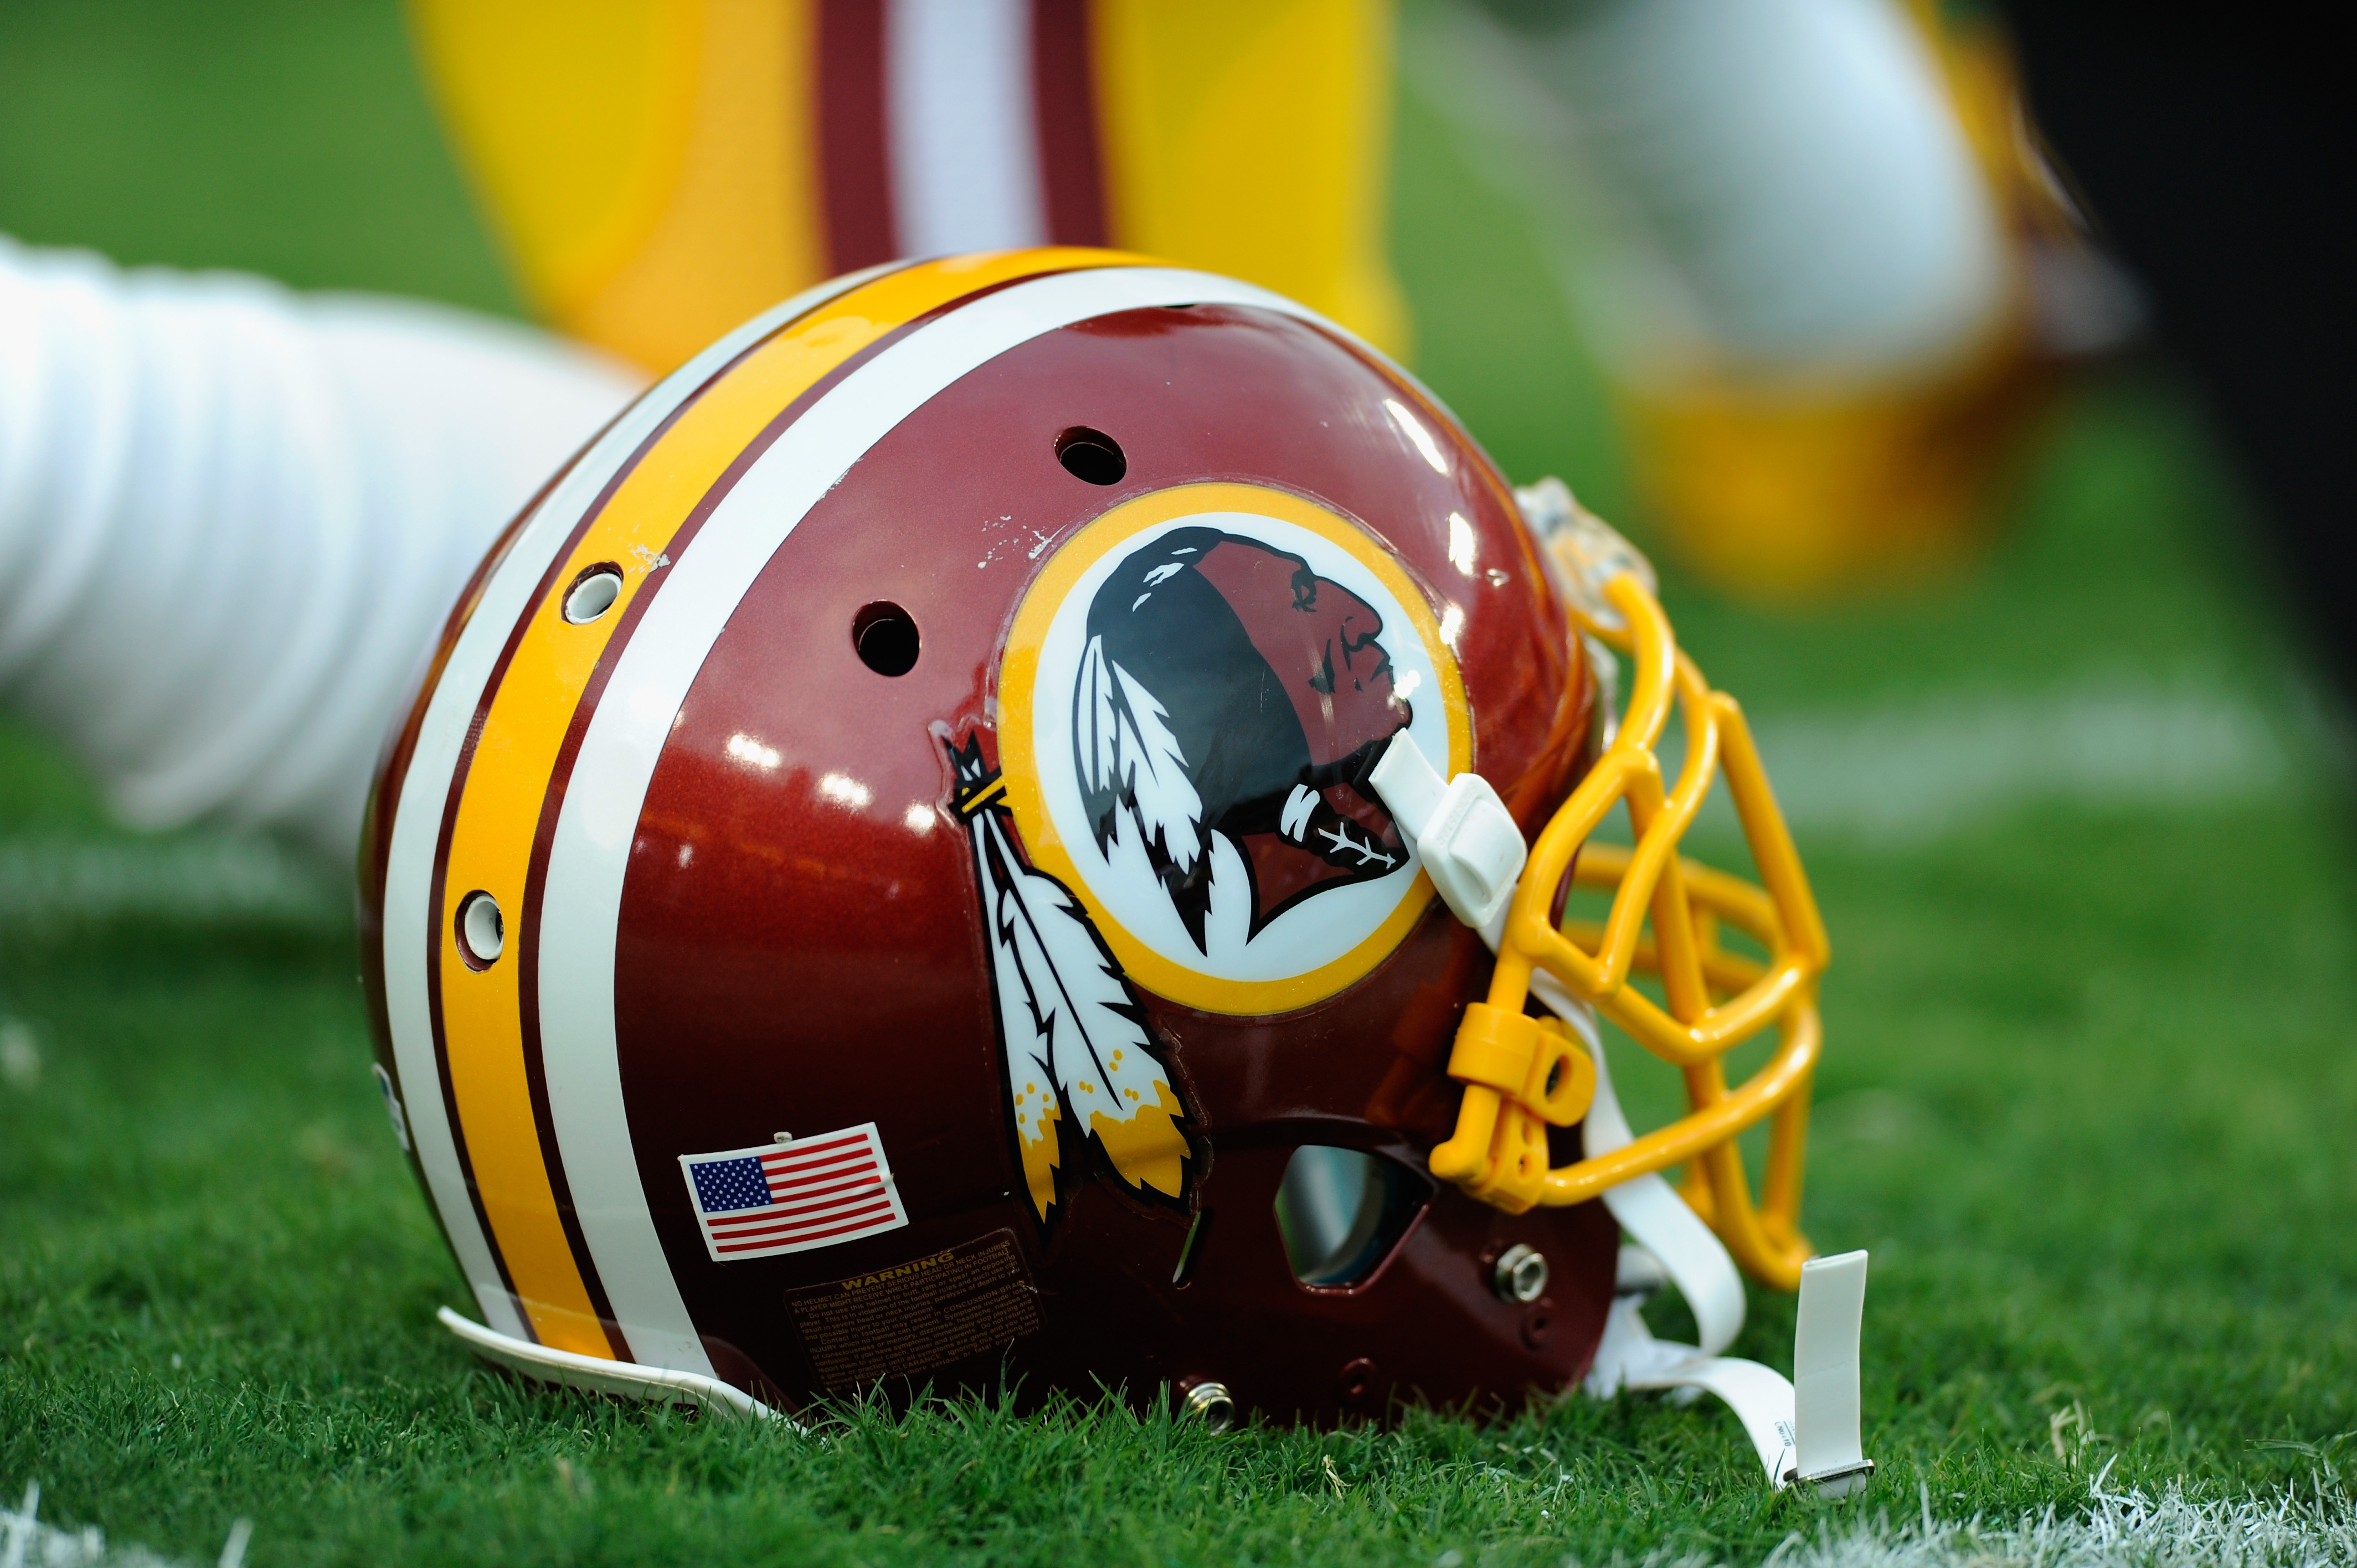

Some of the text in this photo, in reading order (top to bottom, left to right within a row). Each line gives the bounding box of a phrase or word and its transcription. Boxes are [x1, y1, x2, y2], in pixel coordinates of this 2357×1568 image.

[800, 1303, 828, 1312] PLAYER
[829, 1298, 851, 1307] MIGHT
[853, 1291, 884, 1303] RECEIVE
[886, 1283, 908, 1294] WHILE
[909, 1266, 964, 1287] PARTICIPATING
[803, 1295, 832, 1304] HELMET
[851, 1283, 885, 1296] PREVENT
[886, 1273, 920, 1287] SERIOUS
[921, 1266, 942, 1276] HEAD
[943, 1261, 955, 1270] OR
[955, 1254, 976, 1265] NECK
[977, 1239, 1011, 1257] INJURIES
[841, 1252, 954, 1291] WARNING
[857, 1305, 888, 1316] violation
[910, 1289, 937, 1302] football
[939, 1284, 957, 1292] rules
[958, 1278, 972, 1286] and
[972, 1271, 990, 1281] such
[991, 1266, 1004, 1275] use
[866, 1296, 891, 1307] helmet
[948, 1272, 969, 1282] spear
[832, 1321, 855, 1329] severe
[856, 1314, 874, 1323] head
[934, 1288, 967, 1302] paralysis
[977, 1276, 997, 1287] death
[1007, 1267, 1021, 1276] yu
[819, 1328, 849, 1339] possible
[881, 1317, 897, 1326] your
[821, 1335, 849, 1344] Contact
[861, 1325, 890, 1337] football
[910, 1313, 932, 1323] result
[871, 1331, 897, 1340] helmet
[944, 1304, 982, 1320] Symptoms
